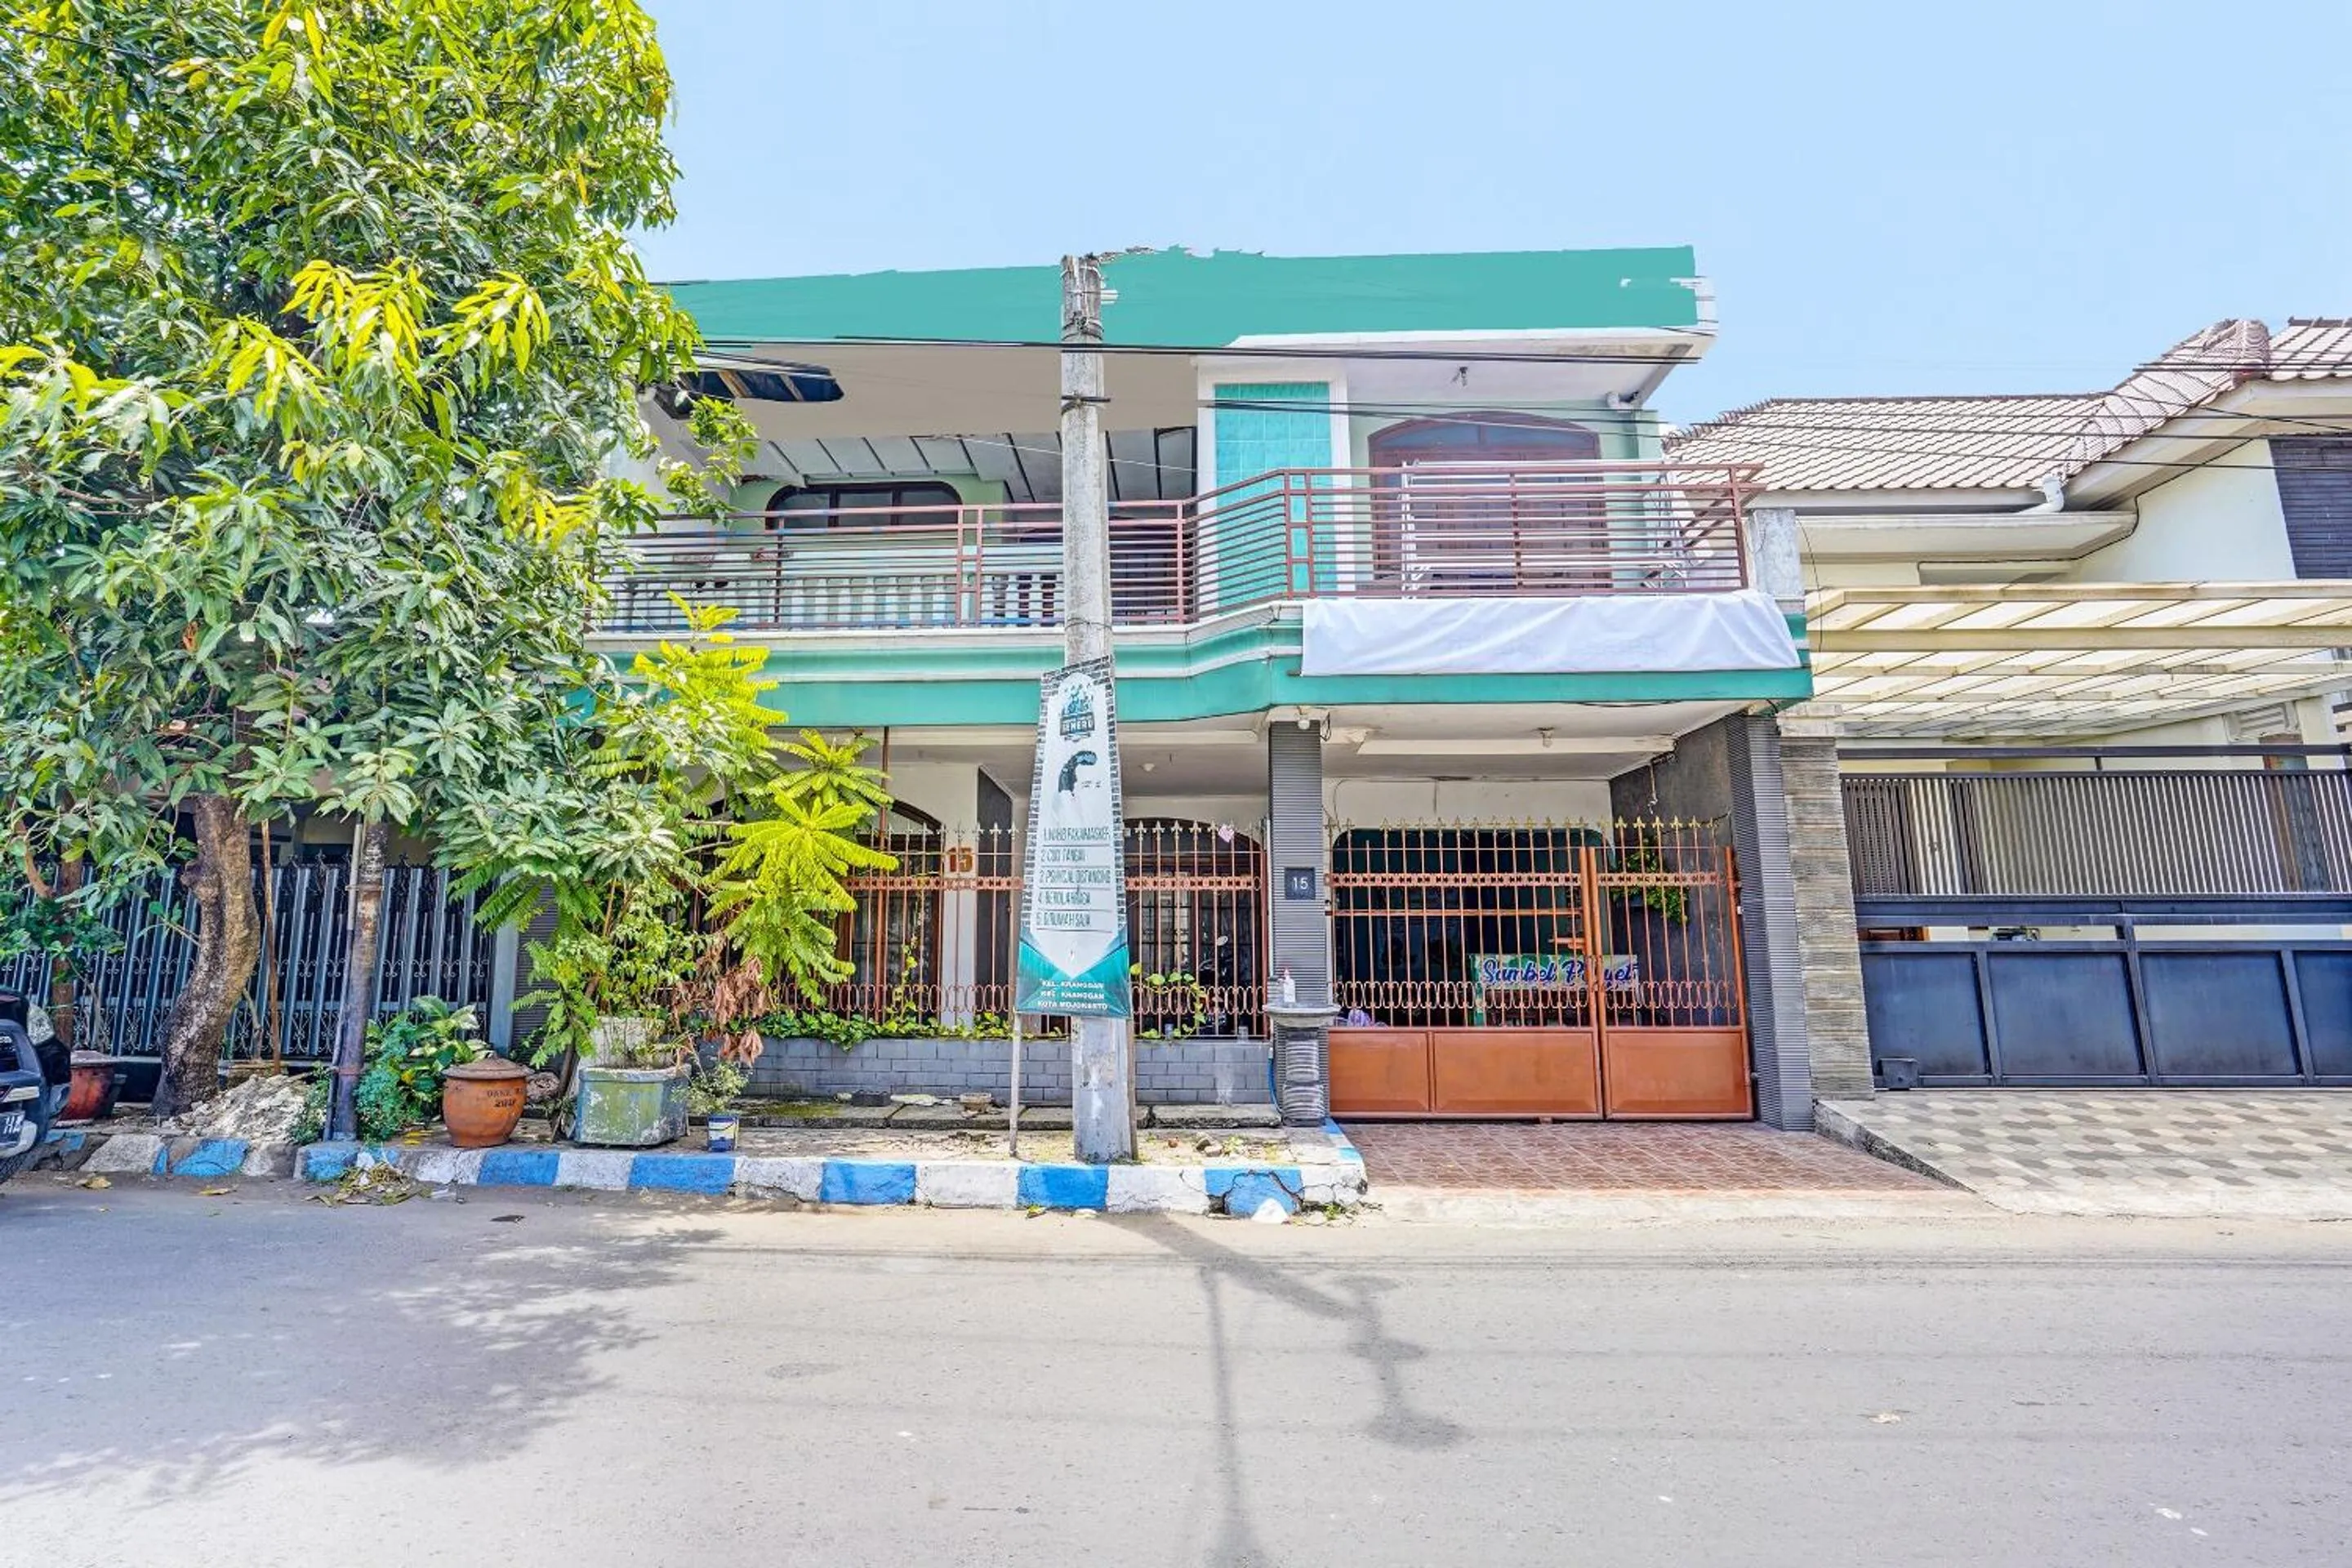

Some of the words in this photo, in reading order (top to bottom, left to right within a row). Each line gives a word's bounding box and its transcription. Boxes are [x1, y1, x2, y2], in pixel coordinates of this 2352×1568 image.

[948, 847, 973, 872] 15
[1292, 876, 1308, 891] 15
[1561, 960, 1639, 988] Pyet
